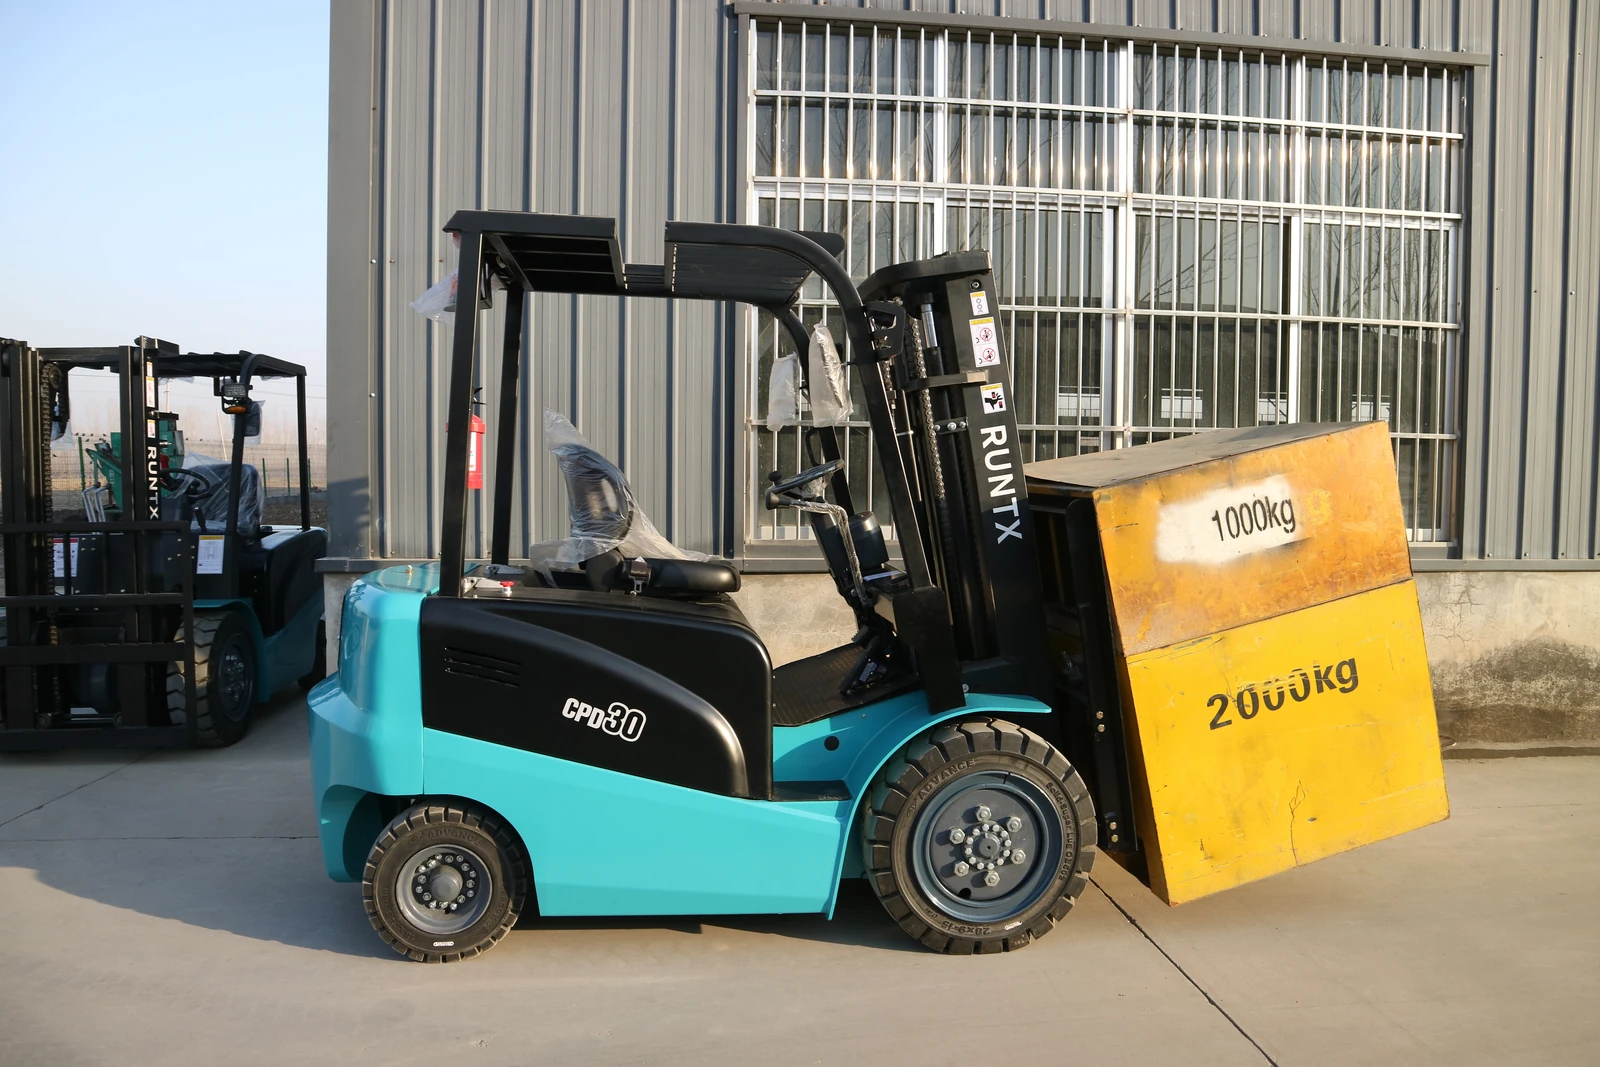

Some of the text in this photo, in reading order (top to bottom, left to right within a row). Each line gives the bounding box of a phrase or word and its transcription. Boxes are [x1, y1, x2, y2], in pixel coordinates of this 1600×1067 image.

[147, 446, 159, 520] RUNTX
[979, 424, 1023, 544] RUNTX
[1212, 496, 1296, 541] 1000kg
[1206, 657, 1360, 731] 2000kg
[562, 697, 646, 742] CPD30
[918, 759, 976, 800] ADVANCE
[428, 828, 481, 846] ADVANCE
